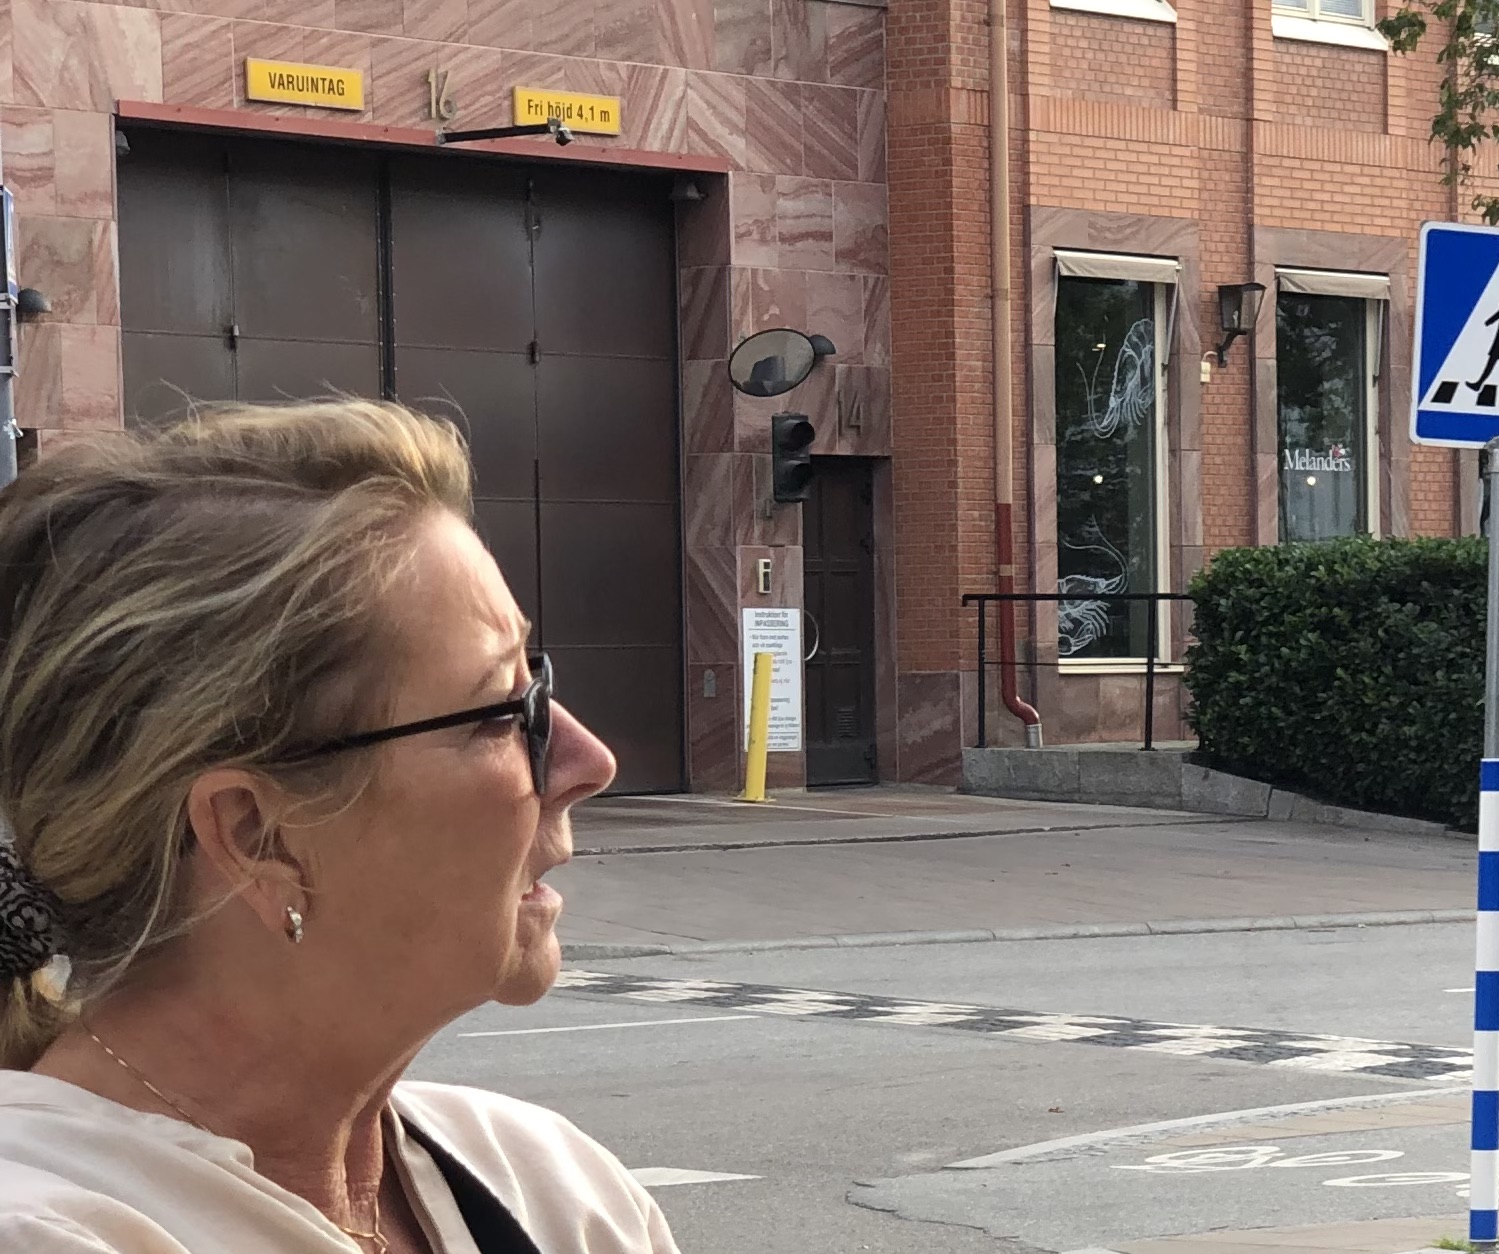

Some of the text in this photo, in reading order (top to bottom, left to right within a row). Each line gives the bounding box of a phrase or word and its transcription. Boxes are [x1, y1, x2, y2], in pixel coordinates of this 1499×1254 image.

[268, 71, 345, 96] VARUINTAG
[427, 69, 458, 120] 16
[527, 99, 611, 123] Fri höjd 4,1 m
[1284, 448, 1351, 472] Melanders
